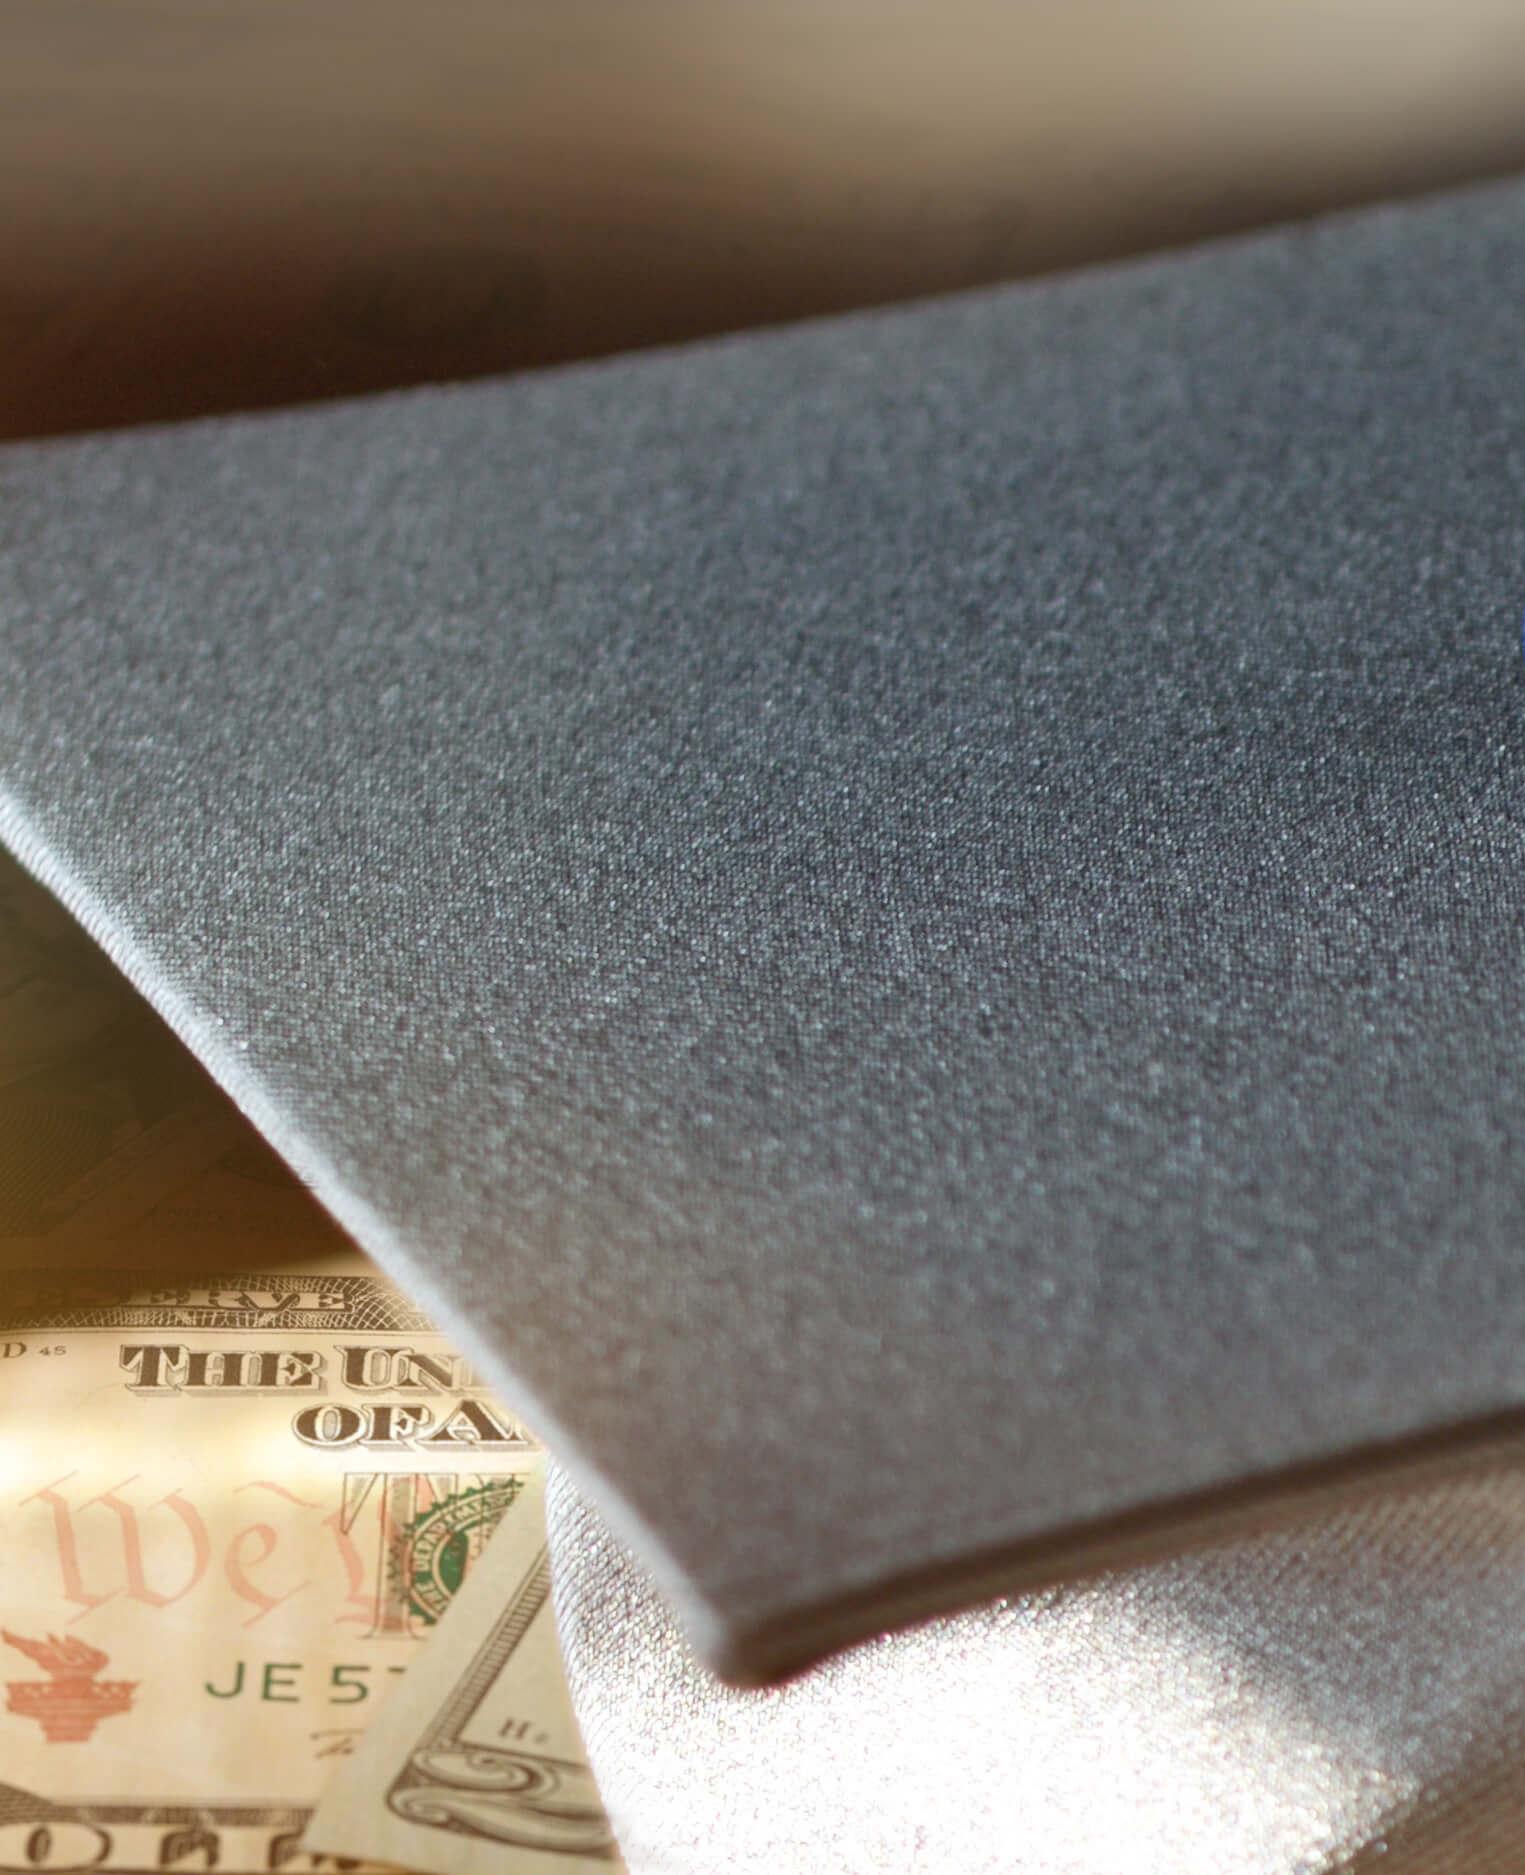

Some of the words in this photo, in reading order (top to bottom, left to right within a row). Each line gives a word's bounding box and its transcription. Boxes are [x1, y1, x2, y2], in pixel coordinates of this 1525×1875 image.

[39, 1345, 67, 1356] 45
[118, 1343, 329, 1397] THE
[18, 1470, 325, 1628] We
[204, 1660, 304, 1703] JE
